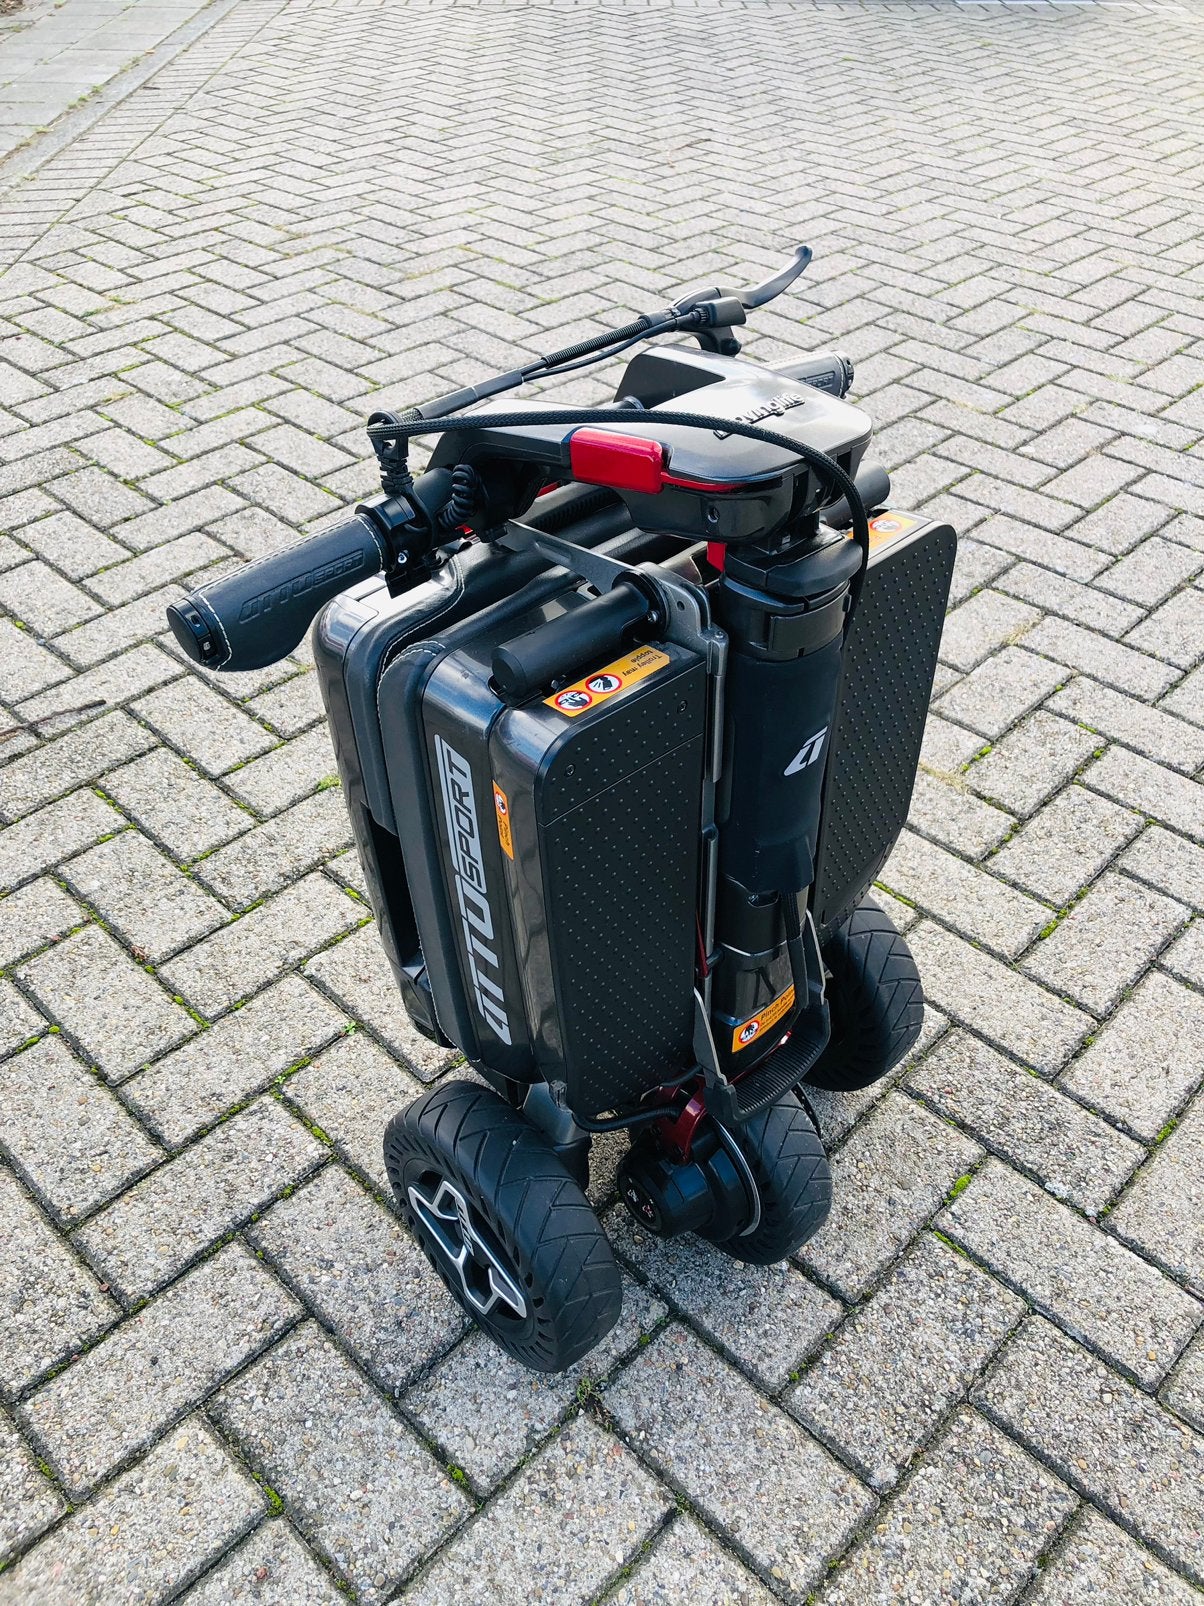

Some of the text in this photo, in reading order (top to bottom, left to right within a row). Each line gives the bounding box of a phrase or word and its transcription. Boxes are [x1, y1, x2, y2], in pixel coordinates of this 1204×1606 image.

[631, 649, 654, 663] topple
[622, 654, 662, 677] Trolley may
